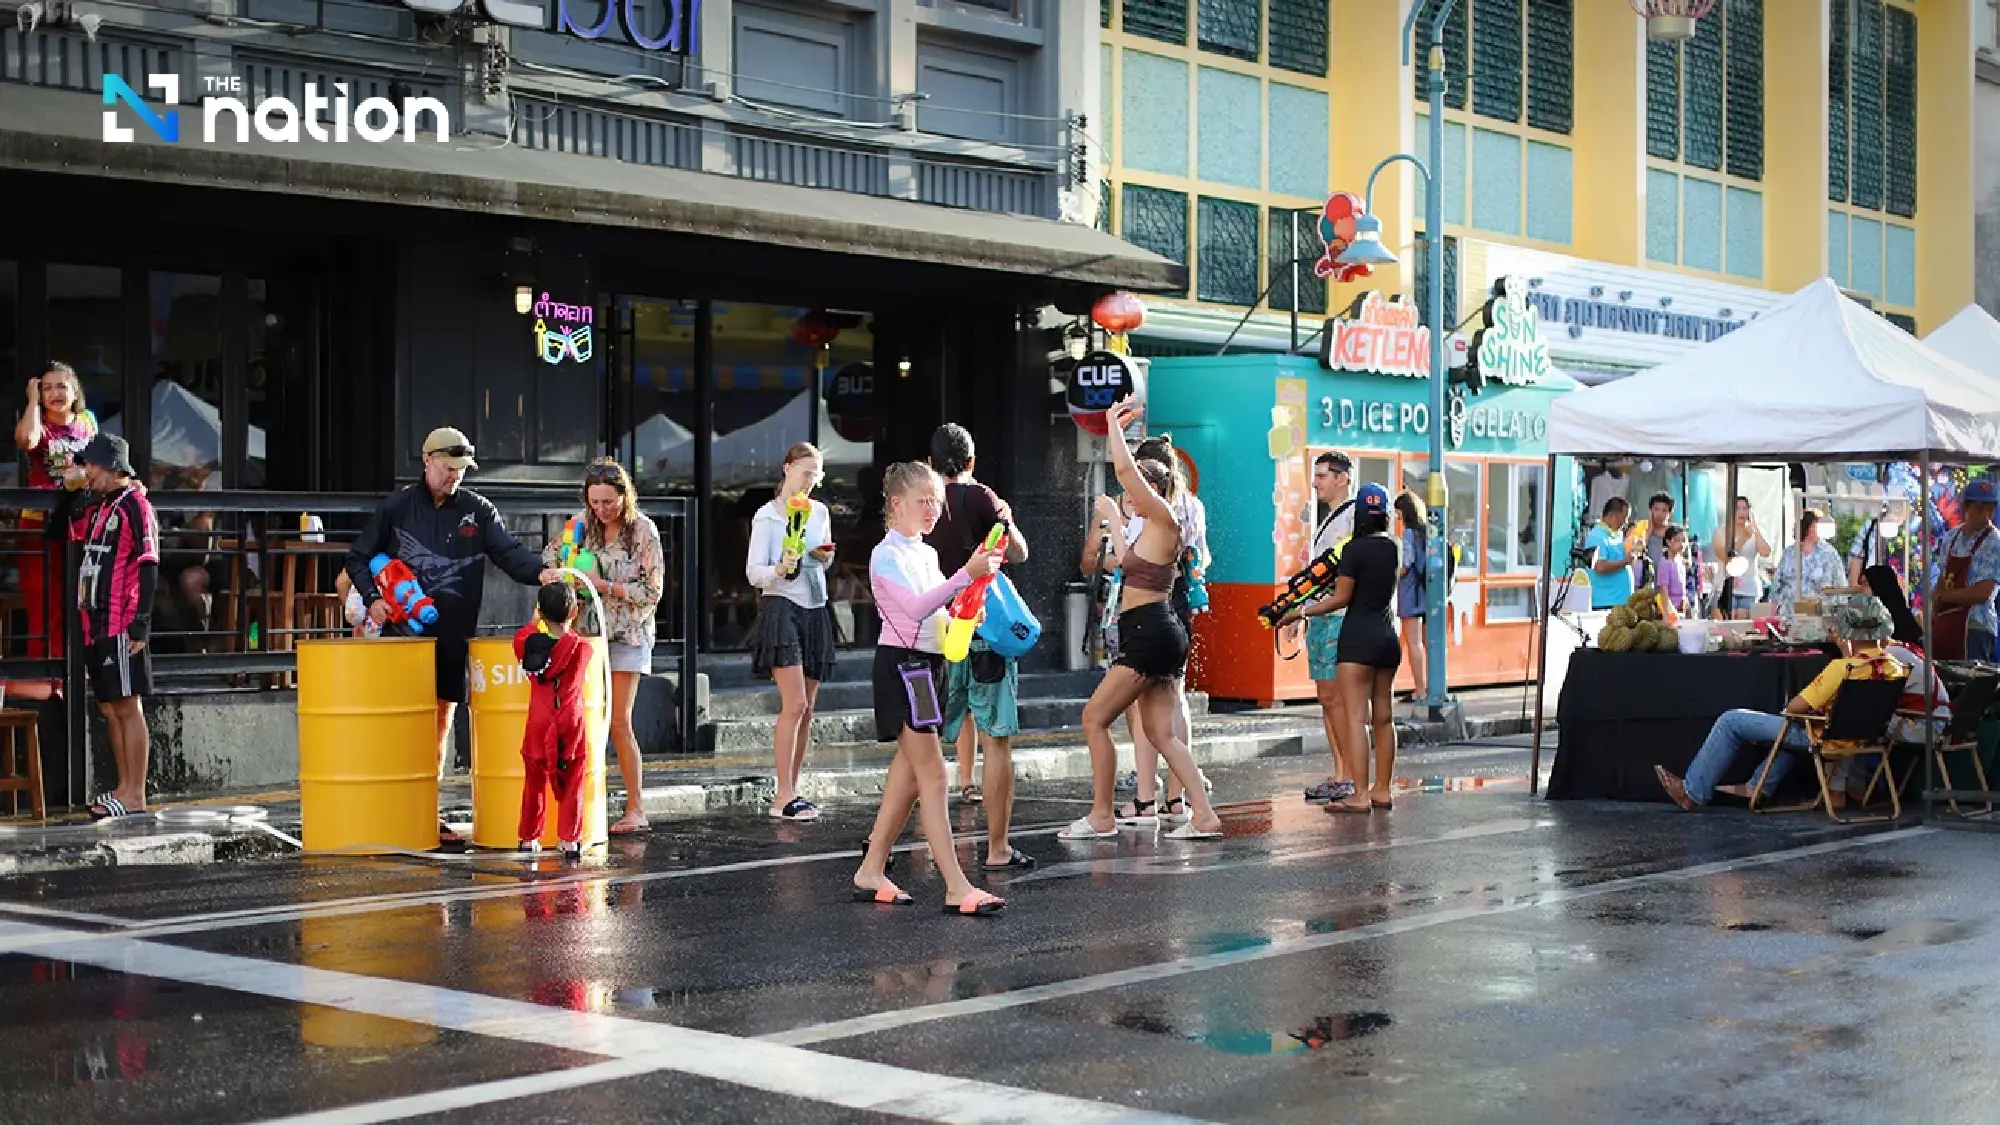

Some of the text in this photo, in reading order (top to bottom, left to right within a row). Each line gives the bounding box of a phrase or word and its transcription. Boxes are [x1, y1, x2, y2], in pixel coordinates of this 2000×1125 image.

[1077, 364, 1122, 386] CUE
[1482, 336, 1546, 377] SHINE
[1362, 401, 1394, 432] ICE
[1401, 402, 1429, 433] PO
[1473, 407, 1547, 441] GELATO
